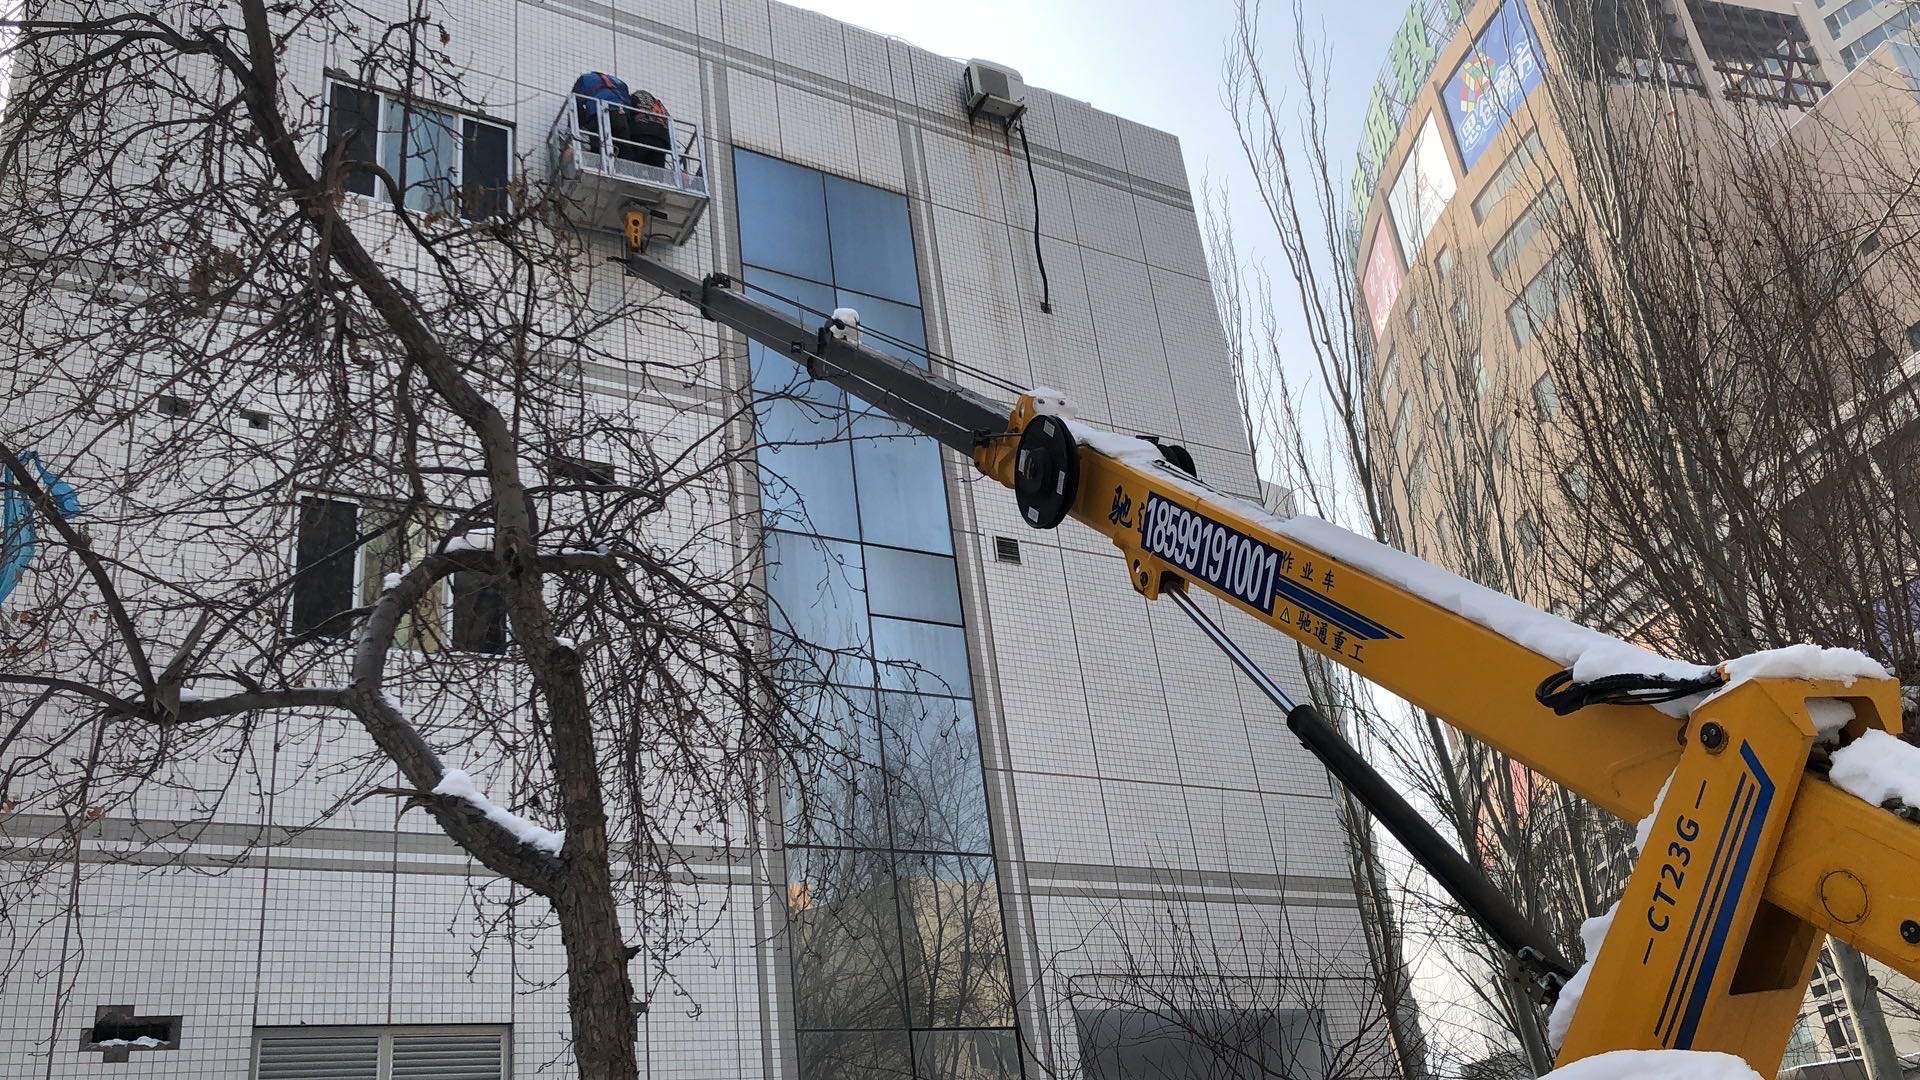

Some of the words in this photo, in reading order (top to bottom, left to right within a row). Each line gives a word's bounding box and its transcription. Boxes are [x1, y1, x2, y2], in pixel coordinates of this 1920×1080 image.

[1109, 485, 1145, 532] 驰
[1146, 497, 1278, 610] 18599191001
[1296, 611, 1364, 664] 驰通重工
